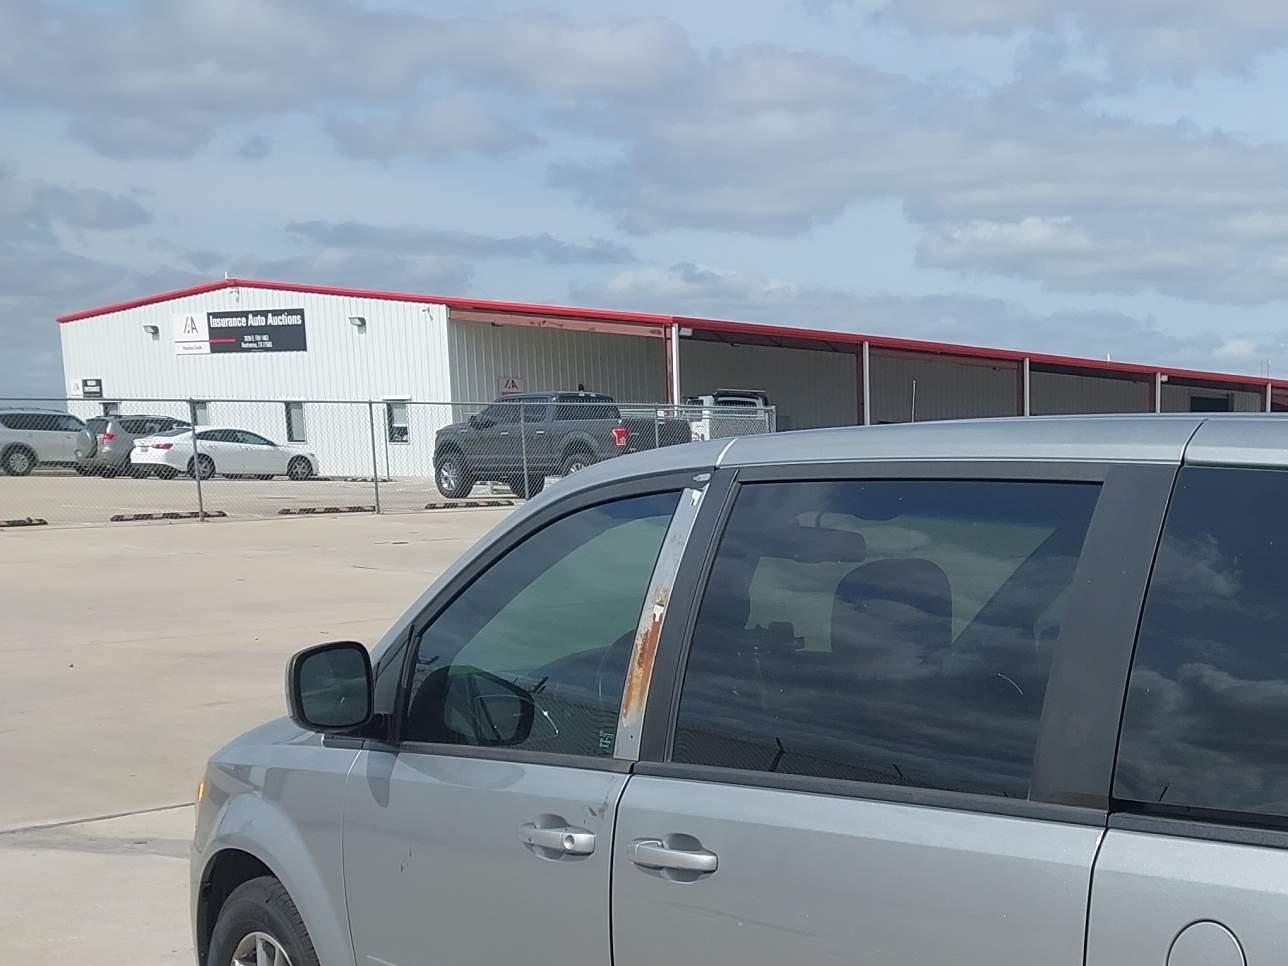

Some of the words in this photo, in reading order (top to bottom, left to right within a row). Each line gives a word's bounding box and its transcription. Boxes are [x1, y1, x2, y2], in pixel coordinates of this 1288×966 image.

[209, 315, 247, 328] Insurance
[247, 313, 266, 326] Auto
[267, 312, 302, 326] Auctions
